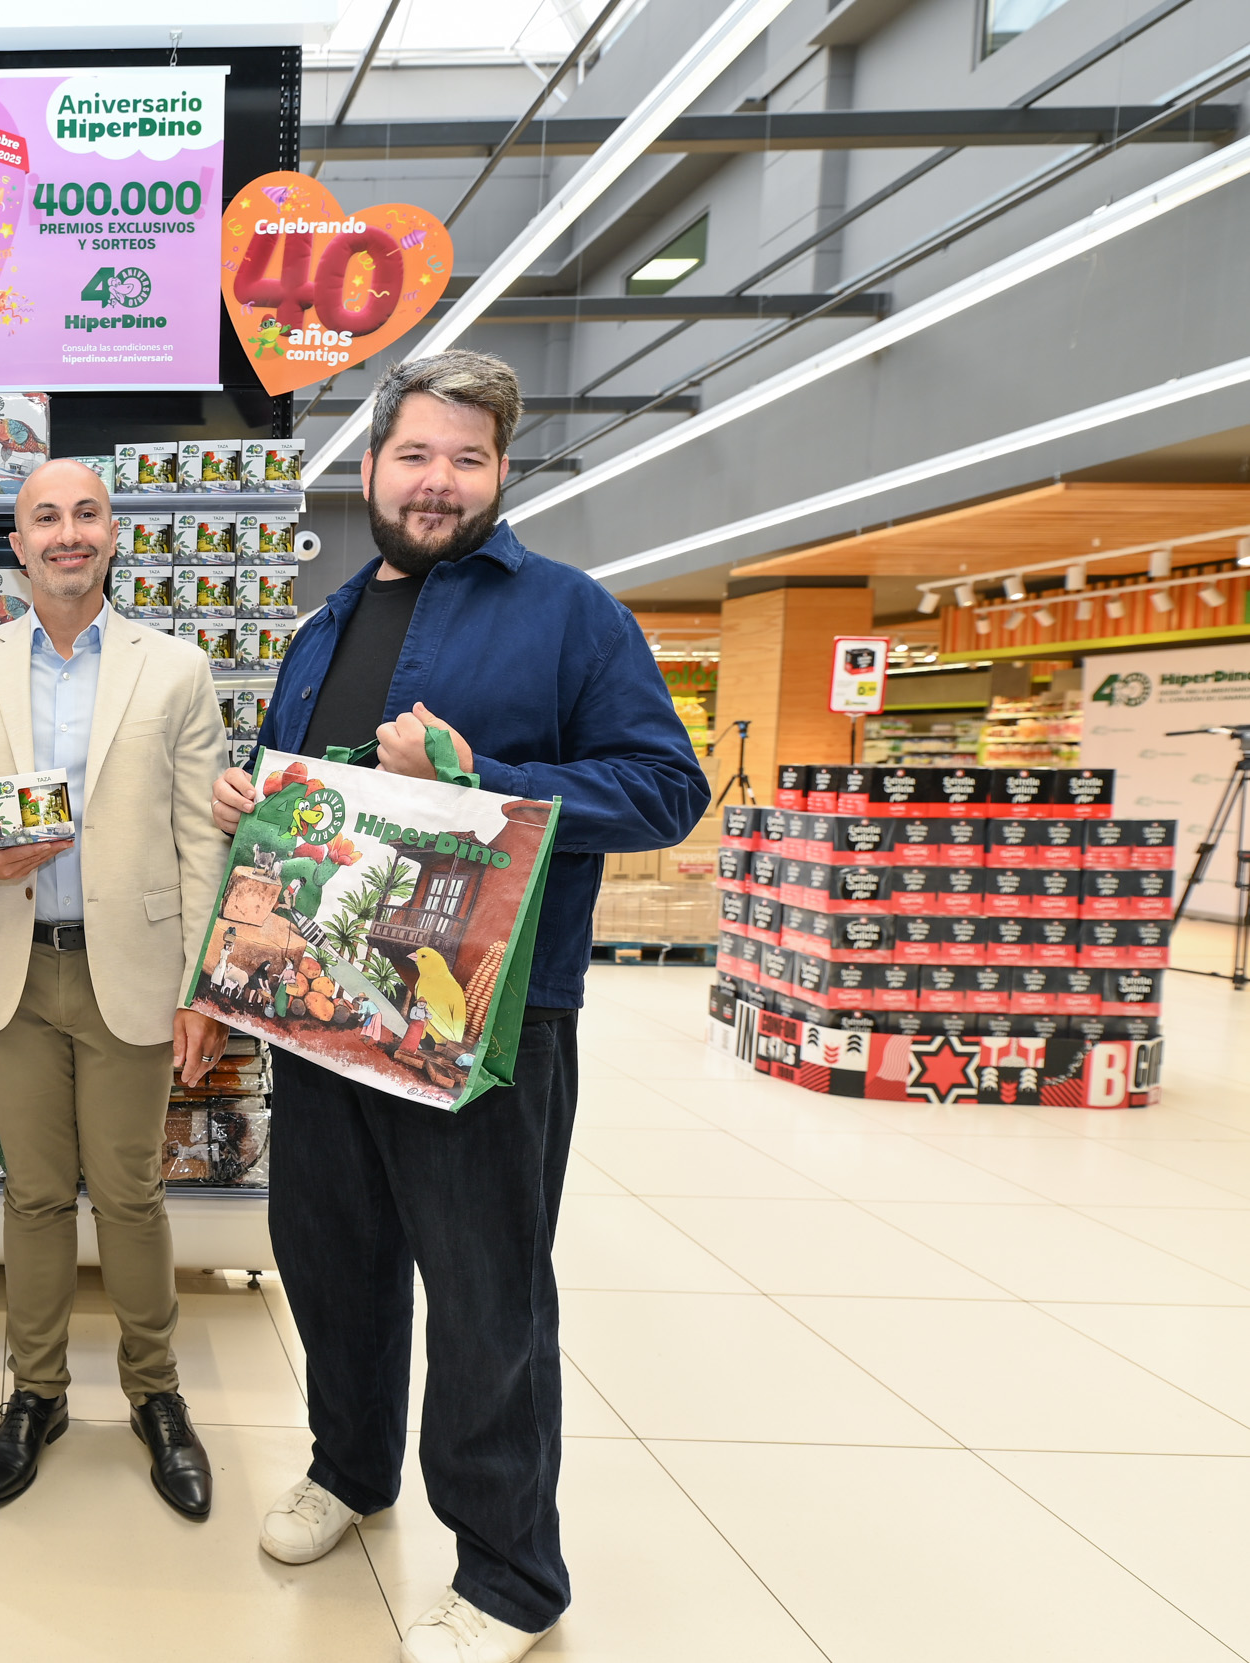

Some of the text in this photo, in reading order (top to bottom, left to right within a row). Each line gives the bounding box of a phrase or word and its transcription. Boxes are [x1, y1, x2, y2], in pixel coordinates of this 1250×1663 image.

[58, 91, 202, 115] Aniversario
[57, 117, 202, 142] HiperDino
[39, 222, 195, 235] PREMIOS EXCLUSIVOS
[254, 217, 367, 235] Celebrando
[78, 238, 156, 250] Y SORTEOS
[121, 268, 151, 308] ANIVERSARIO
[234, 223, 404, 338] 40
[64, 314, 167, 332] HiperDino
[288, 323, 353, 347] años
[62, 343, 174, 352] Consulta las condiciones en
[286, 347, 349, 367] contigo
[62, 354, 173, 365] hiperdino.es/aniversario
[310, 791, 343, 842] ANIVERSARIO
[354, 812, 511, 869] HiperDino
